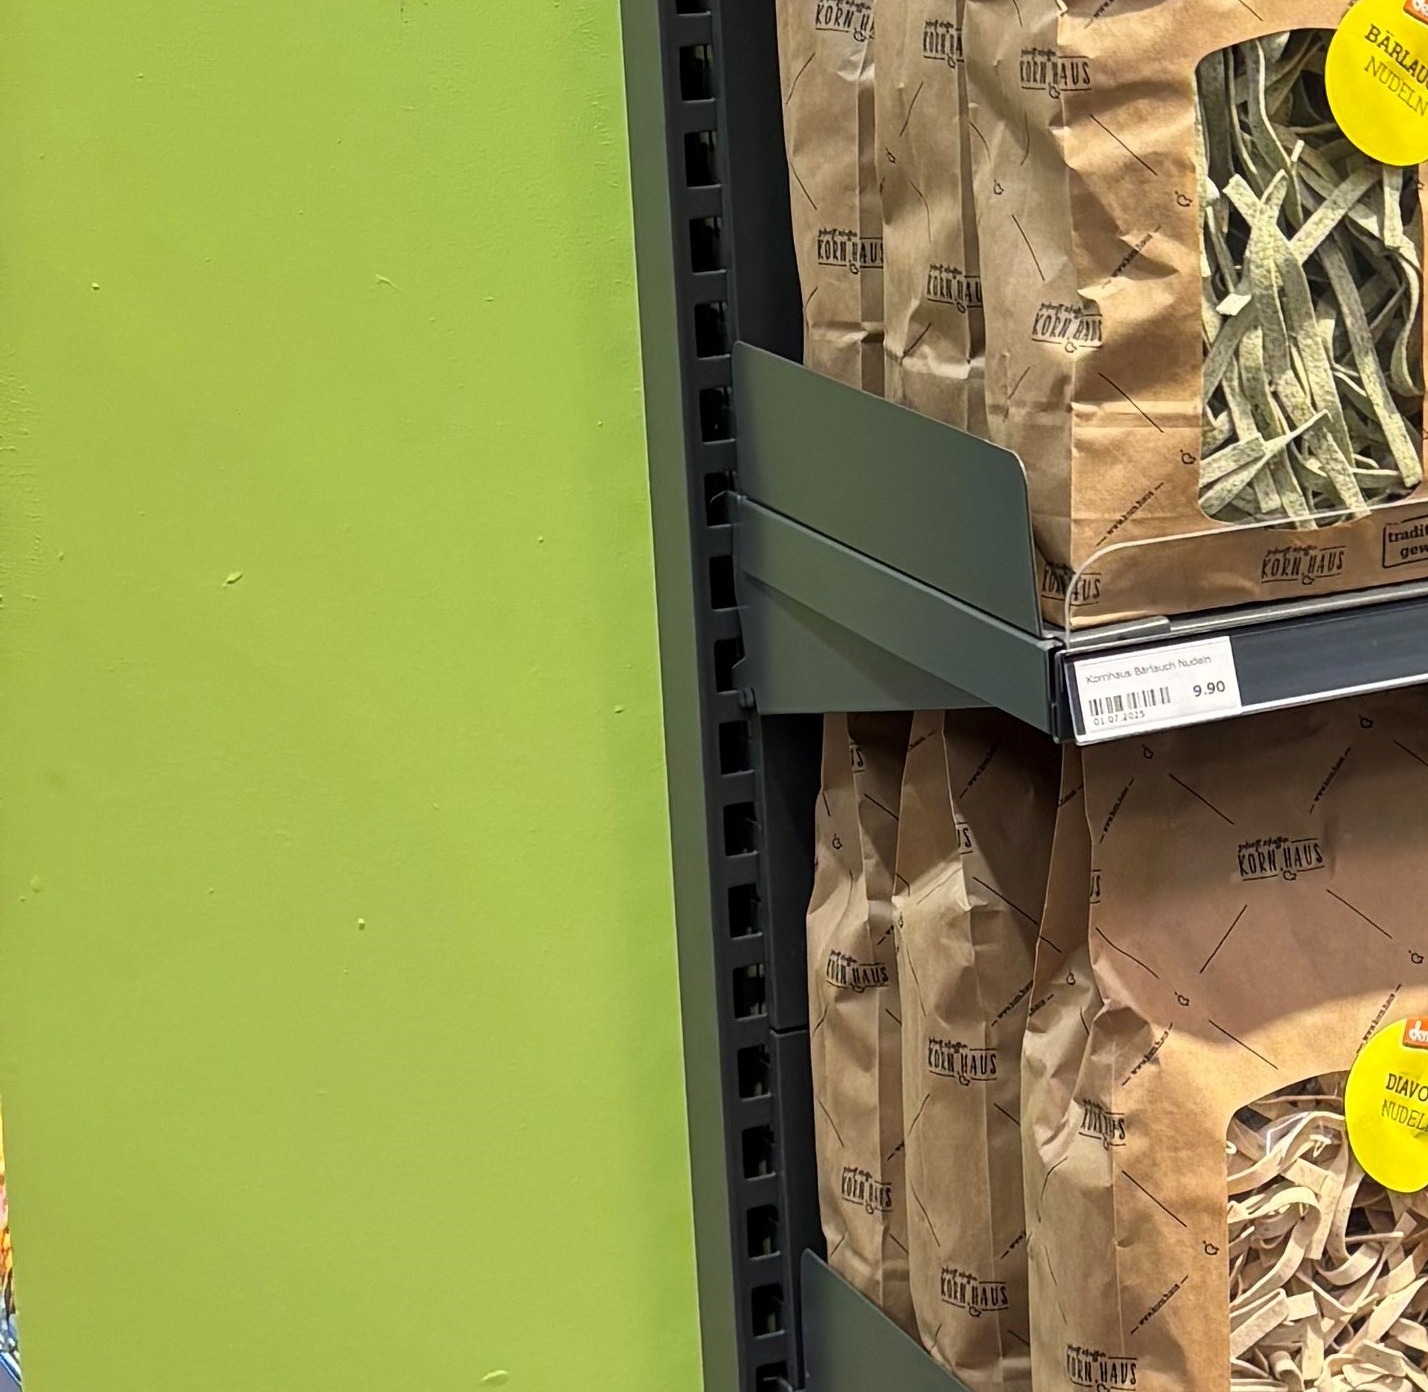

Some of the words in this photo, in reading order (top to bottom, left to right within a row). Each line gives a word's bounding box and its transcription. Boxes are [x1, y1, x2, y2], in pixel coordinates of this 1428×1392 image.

[1260, 556, 1301, 578] KORN
[1307, 549, 1344, 575] HAUS
[1086, 671, 1132, 684] Kornhaus
[1135, 662, 1175, 676] Bärlauch
[1178, 656, 1212, 669] Nudeln
[1193, 680, 1225, 697] 9.90
[1238, 850, 1277, 876] KORN
[1283, 843, 1324, 870] HAUS
